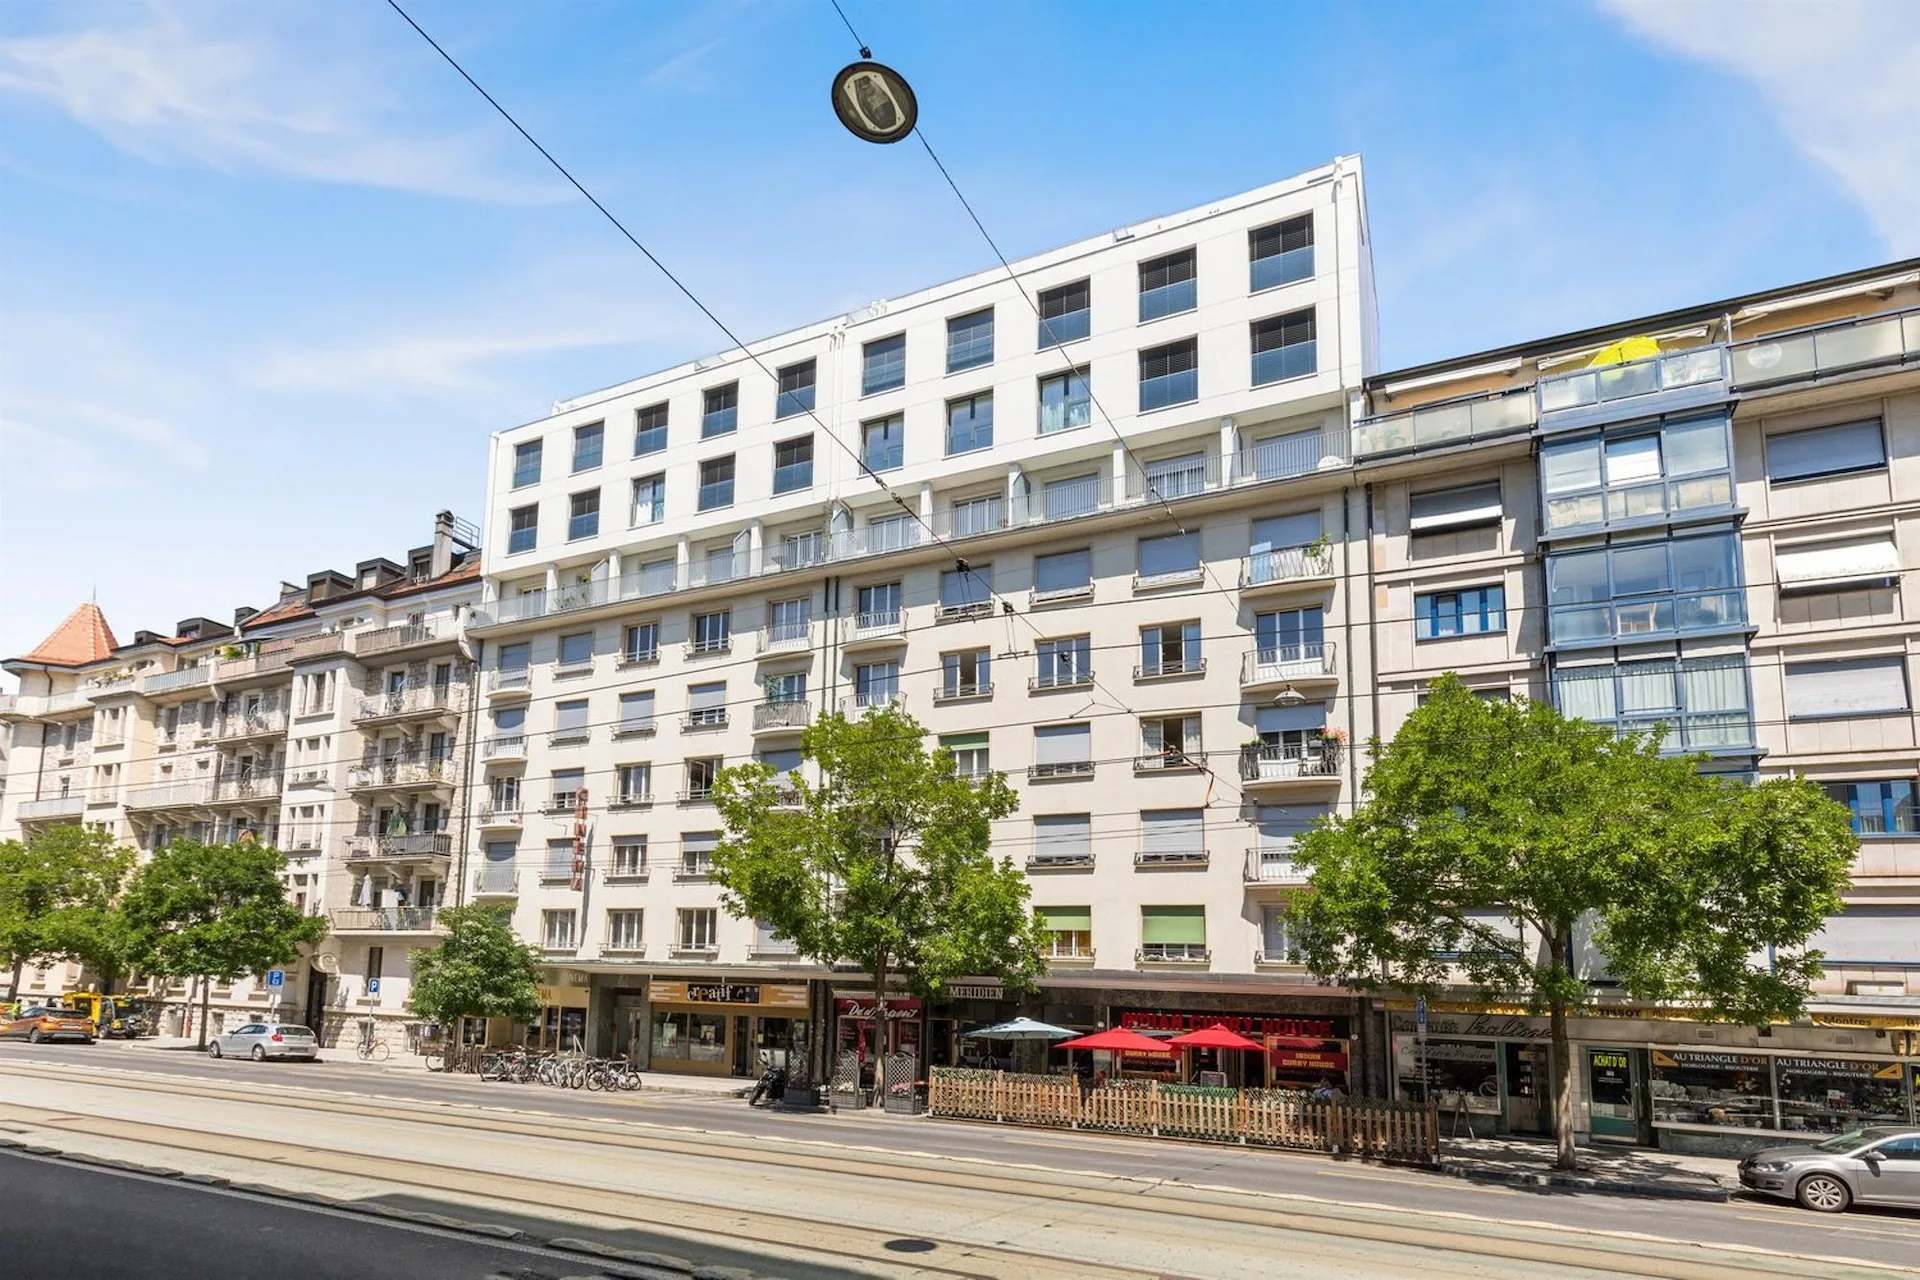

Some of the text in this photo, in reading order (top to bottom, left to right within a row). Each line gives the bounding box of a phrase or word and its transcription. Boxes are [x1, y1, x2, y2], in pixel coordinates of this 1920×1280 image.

[371, 981, 378, 991] P
[949, 986, 1004, 999] MERIDIEN
[1600, 1008, 1641, 1017] TISSOT
[1121, 1012, 1335, 1038] INDIAN CURRY HOUSE
[1823, 1015, 1872, 1026] Montres
[1282, 1060, 1335, 1069] CURRY HOUSE
[1593, 1055, 1612, 1067] ACHAT
[1689, 1054, 1738, 1063] TRIANGLE
[1740, 1056, 1769, 1065] D'OR
[1776, 1058, 1880, 1071] AU TRIANGLE D'OR
